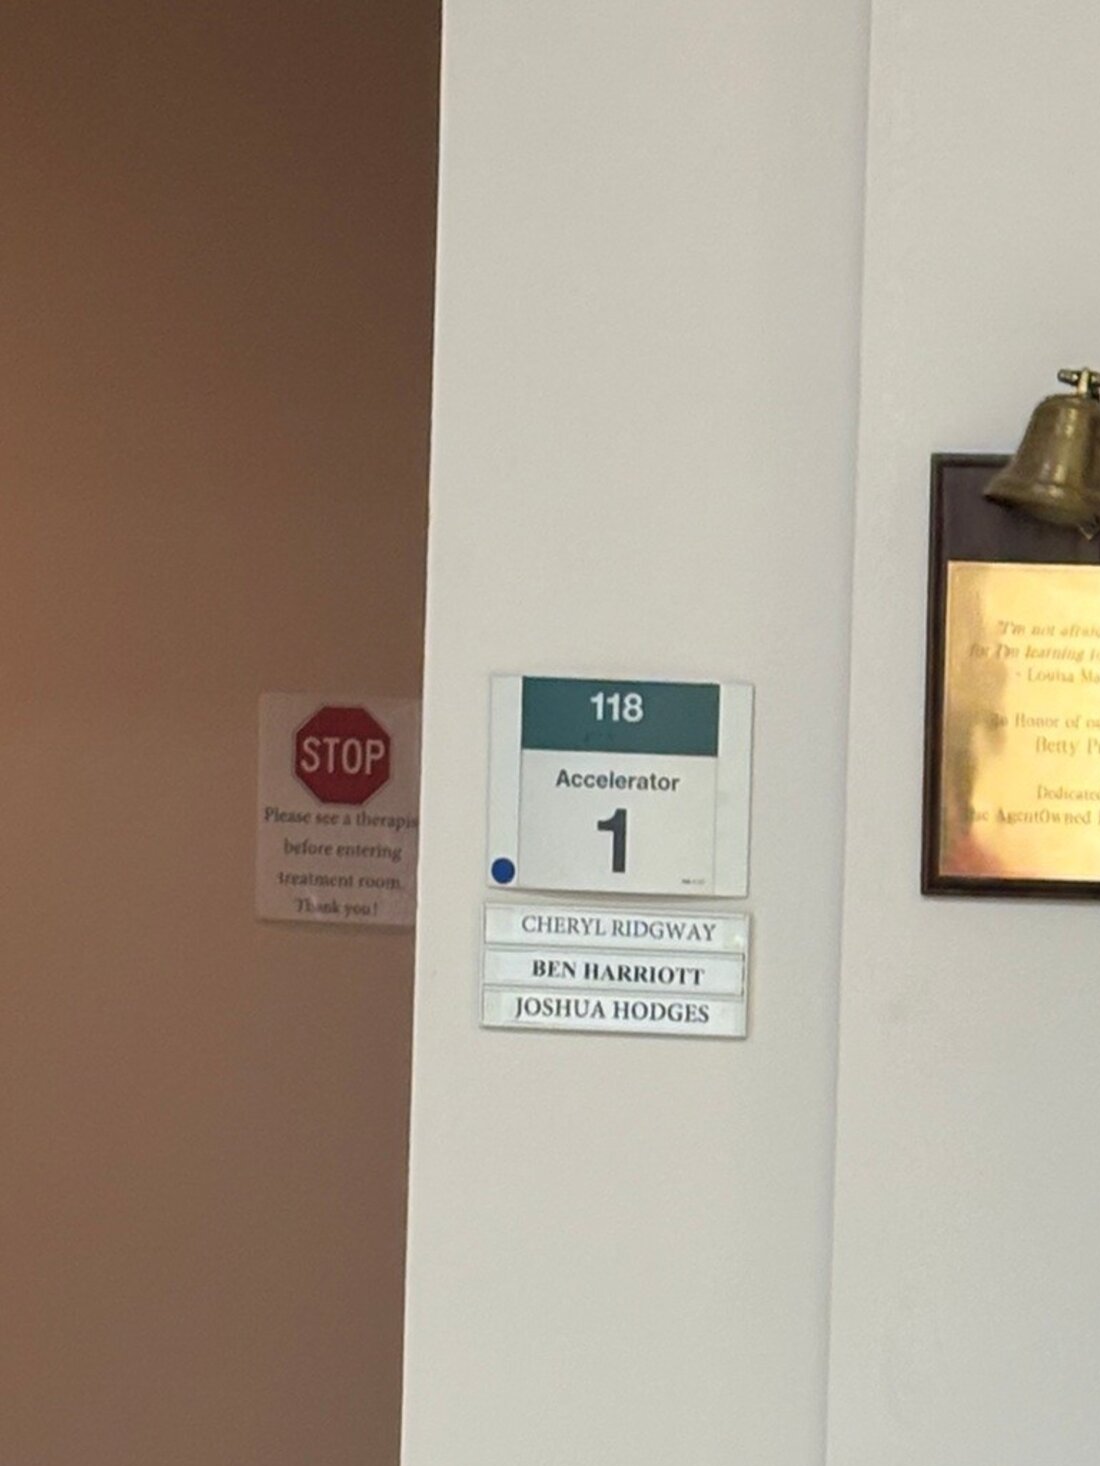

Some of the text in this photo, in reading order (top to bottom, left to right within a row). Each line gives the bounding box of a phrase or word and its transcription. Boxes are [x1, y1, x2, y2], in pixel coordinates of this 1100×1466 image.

[1025, 644, 1085, 663] learning
[1027, 668, 1075, 684] Louisa
[590, 691, 644, 723] 118
[1014, 712, 1059, 729] Honor
[1064, 713, 1081, 729] of
[301, 736, 386, 775] STOP
[1036, 736, 1079, 757] Betty
[555, 768, 680, 792] Accelerator
[264, 806, 311, 824] Please
[315, 811, 340, 826] see
[342, 814, 352, 827] a
[283, 836, 403, 864] before entering
[597, 808, 627, 873] 1
[278, 871, 354, 888] treatment
[343, 901, 378, 918] you!
[522, 915, 717, 942] CHERYL RIDGWAY
[532, 959, 705, 986] BEN HARRIOTT
[515, 997, 710, 1025] JOSHUA HODGES
